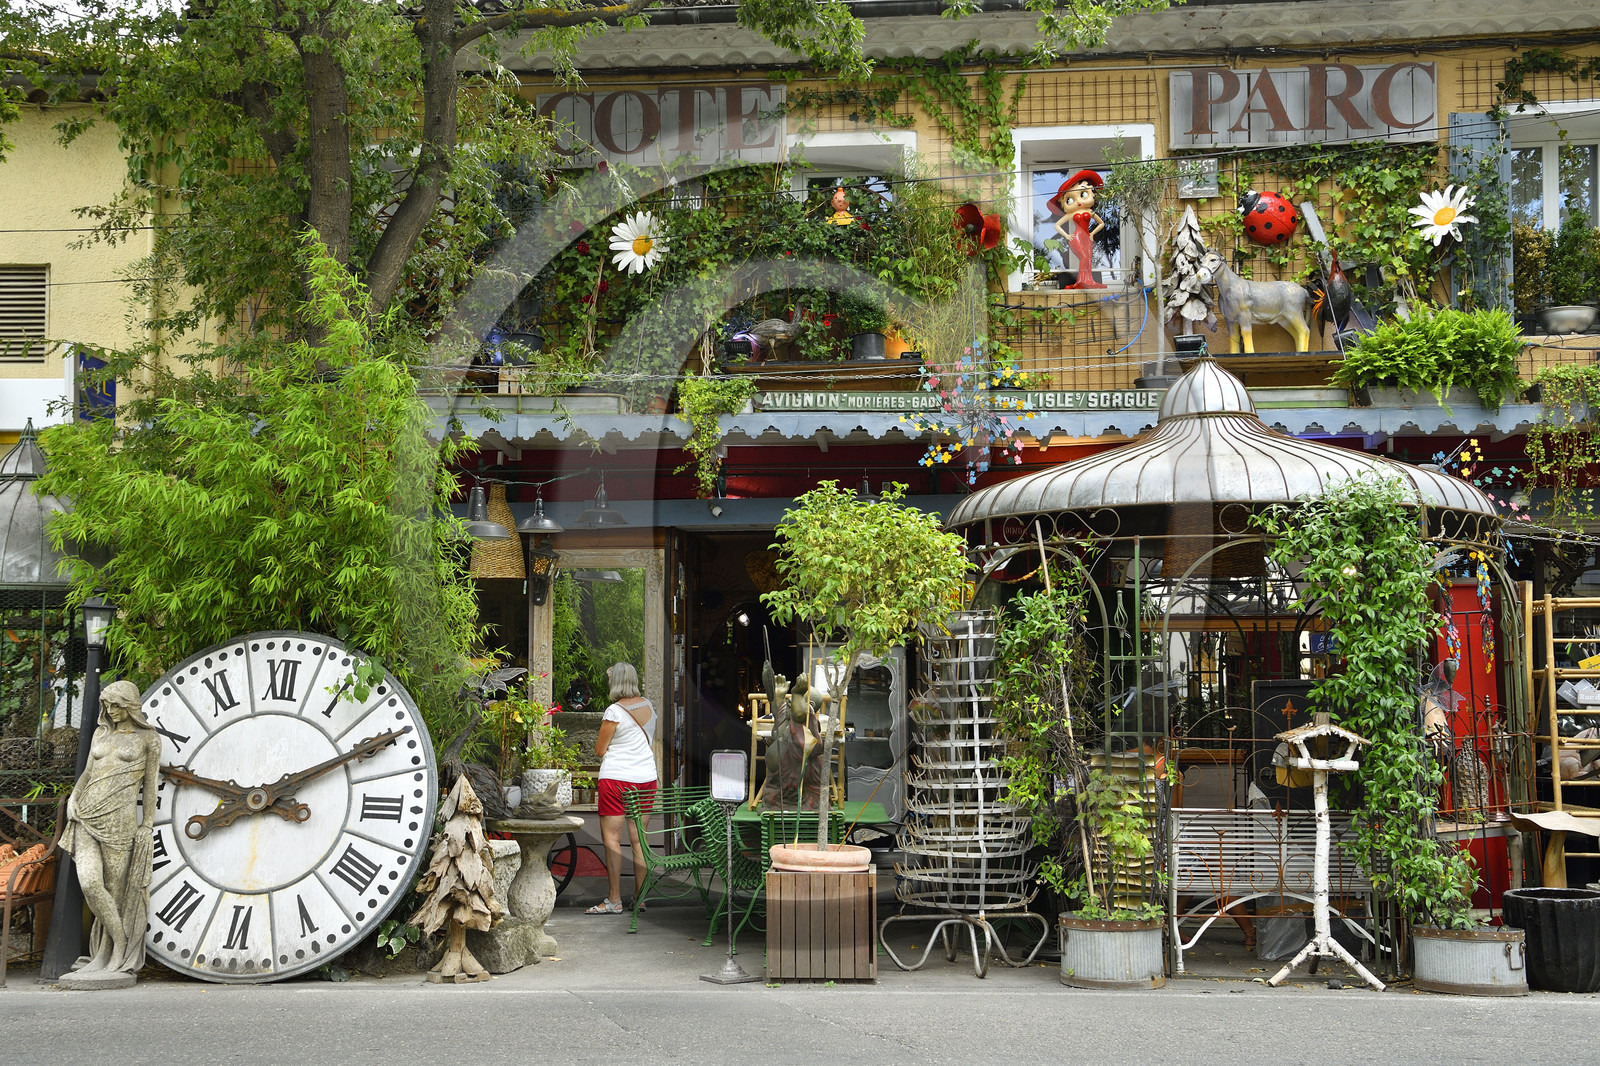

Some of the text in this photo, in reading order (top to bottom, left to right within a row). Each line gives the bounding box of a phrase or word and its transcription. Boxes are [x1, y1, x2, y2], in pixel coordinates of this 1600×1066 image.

[540, 84, 777, 155] COTE
[1184, 61, 1435, 135] PARC
[1179, 159, 1216, 174] OUST
[1088, 392, 1158, 408] SORGUE
[201, 669, 240, 717] XI
[262, 659, 301, 702] XII
[360, 793, 403, 823] III
[329, 843, 382, 895] IIII
[155, 880, 206, 933] VII
[223, 905, 252, 950] VI
[297, 894, 319, 938] V
